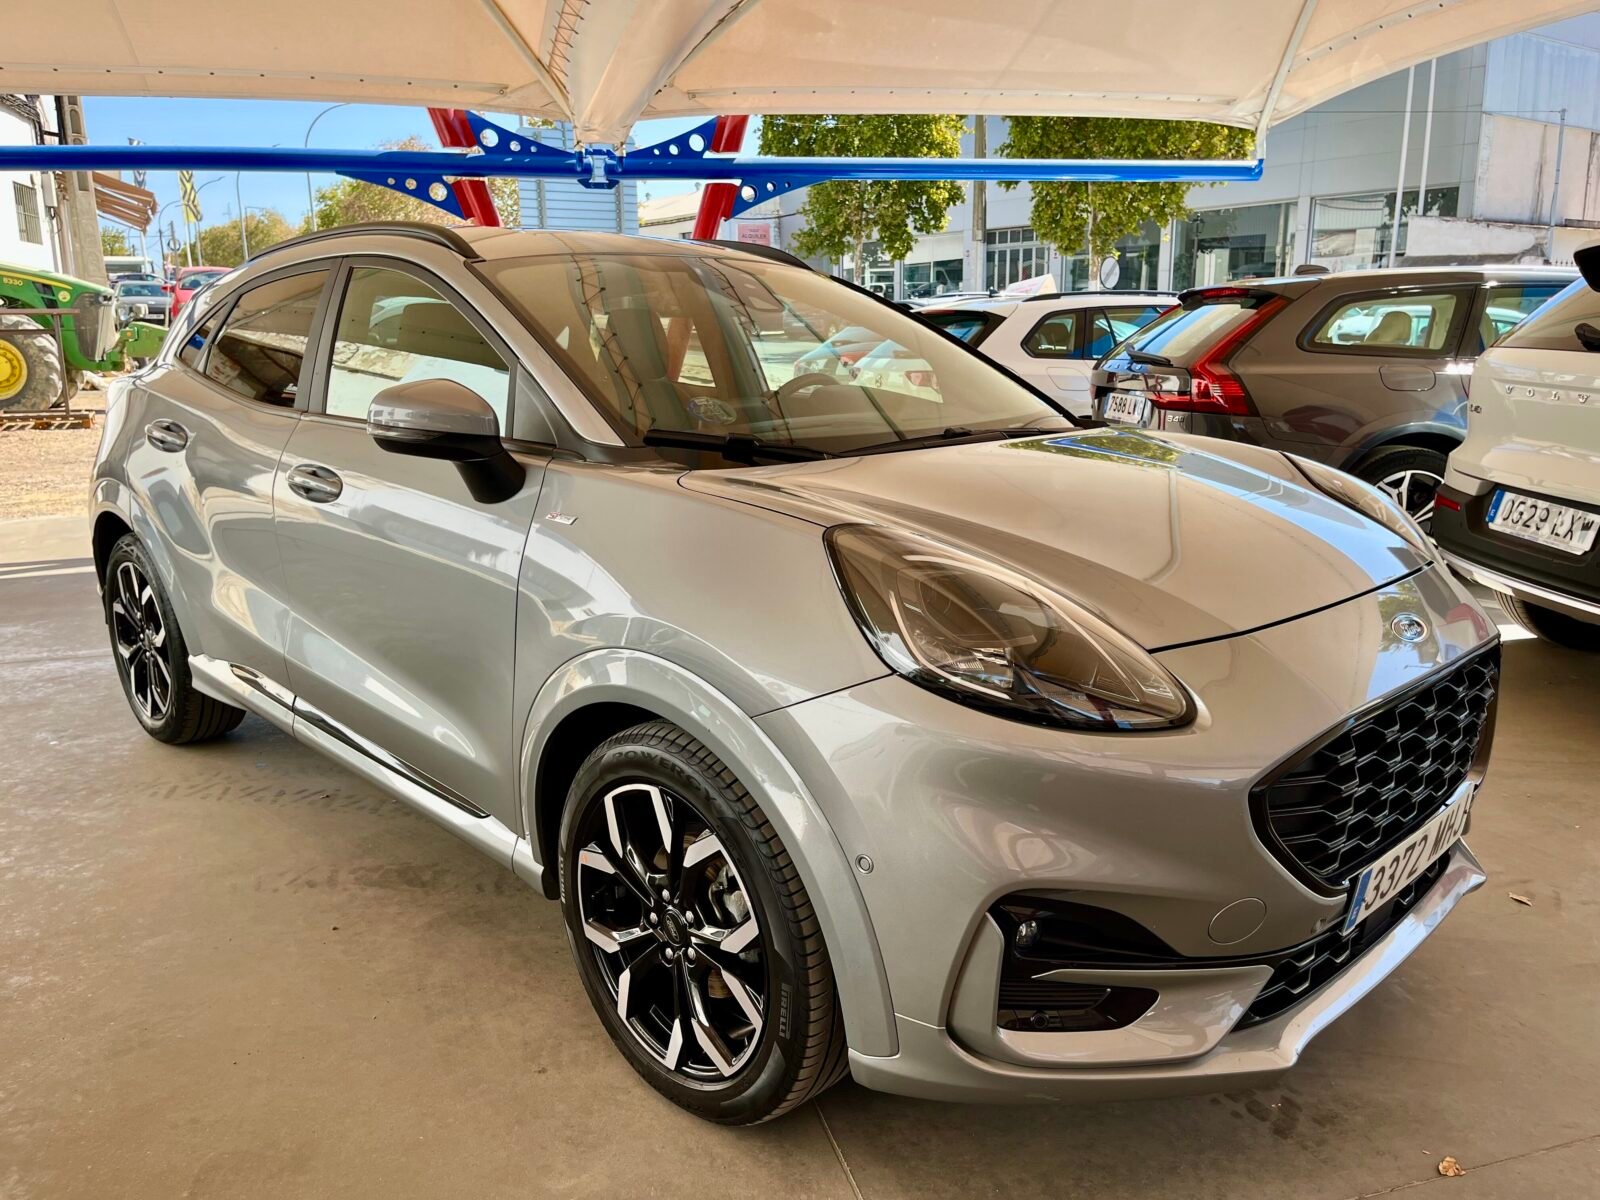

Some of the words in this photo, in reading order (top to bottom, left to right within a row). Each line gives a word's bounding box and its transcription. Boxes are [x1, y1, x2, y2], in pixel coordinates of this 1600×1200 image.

[1364, 833, 1429, 911] 3372
[1427, 793, 1471, 862] MHJ
[779, 983, 793, 1040] PIRELLI
